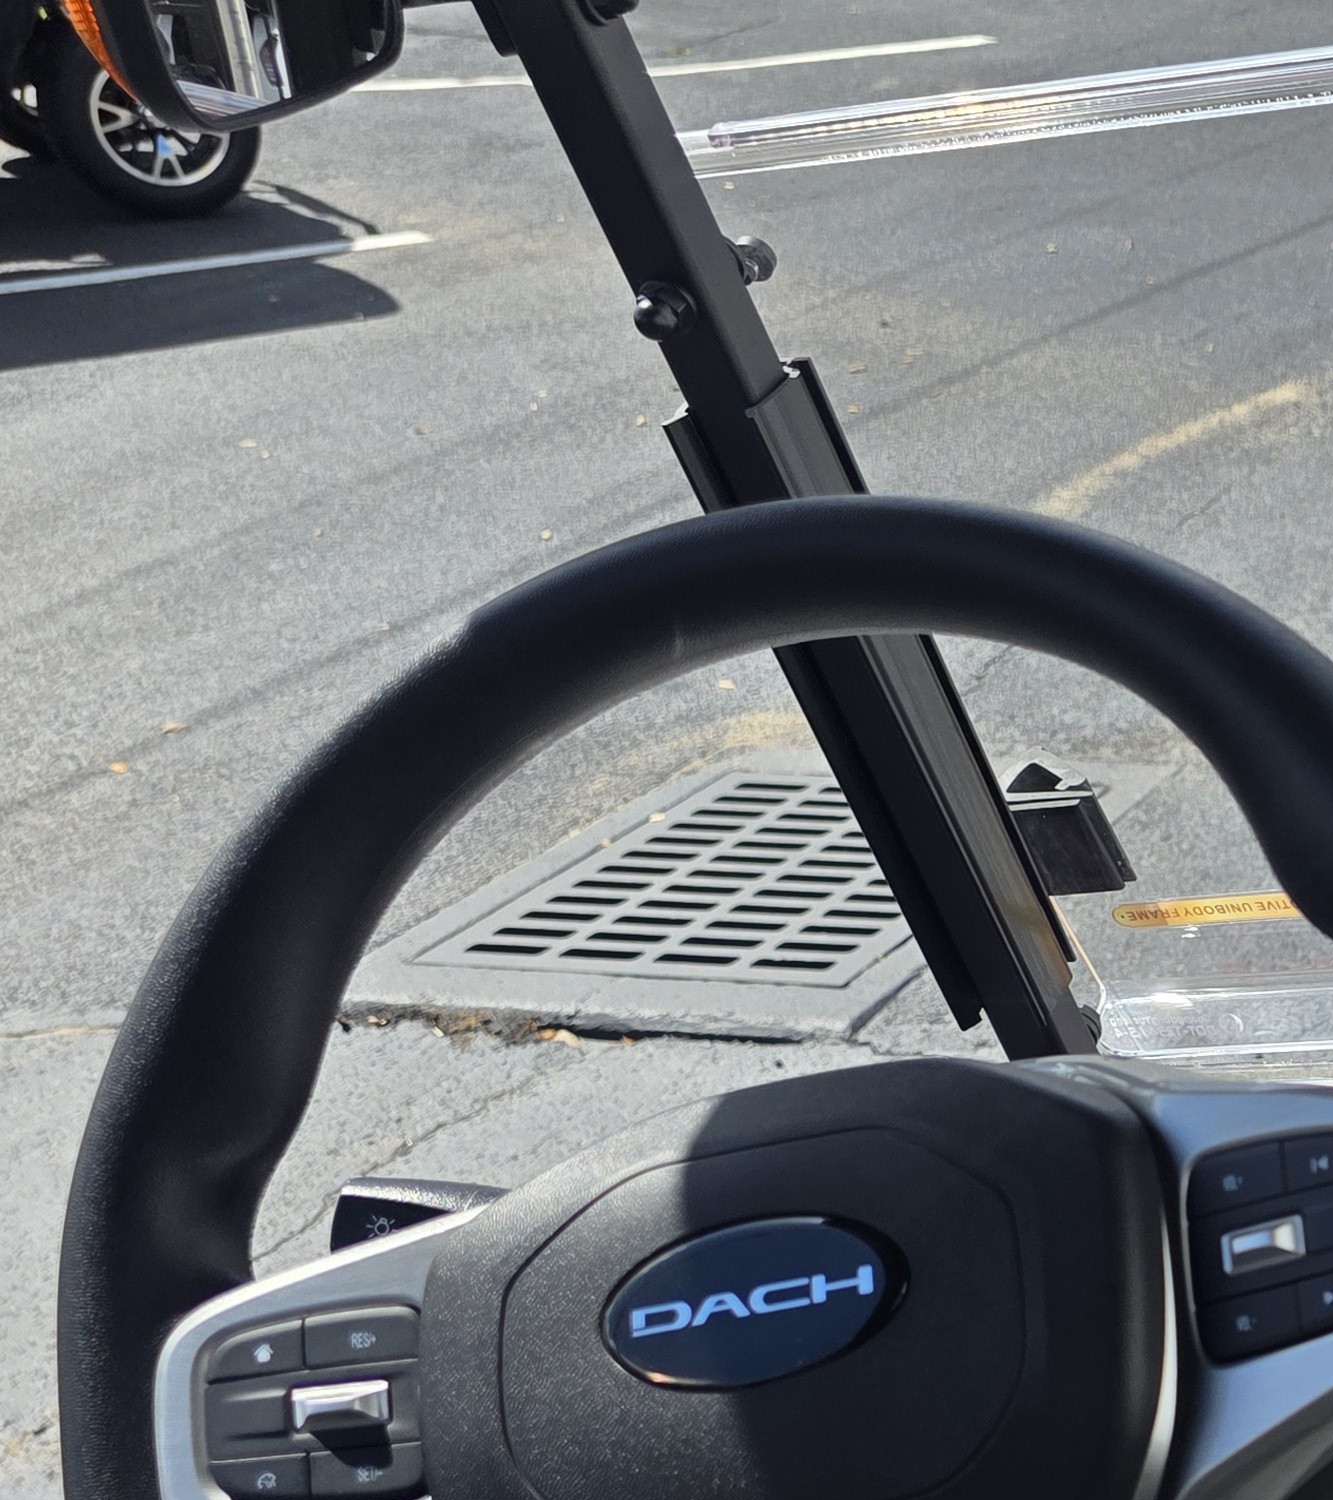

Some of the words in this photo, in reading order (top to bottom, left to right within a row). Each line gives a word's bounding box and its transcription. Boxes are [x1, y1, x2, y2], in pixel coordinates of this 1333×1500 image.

[1182, 901, 1254, 917] UNIBODY
[1254, 898, 1295, 913] TIVE
[1126, 907, 1180, 922] FRAME
[629, 1264, 876, 1339] DACH
